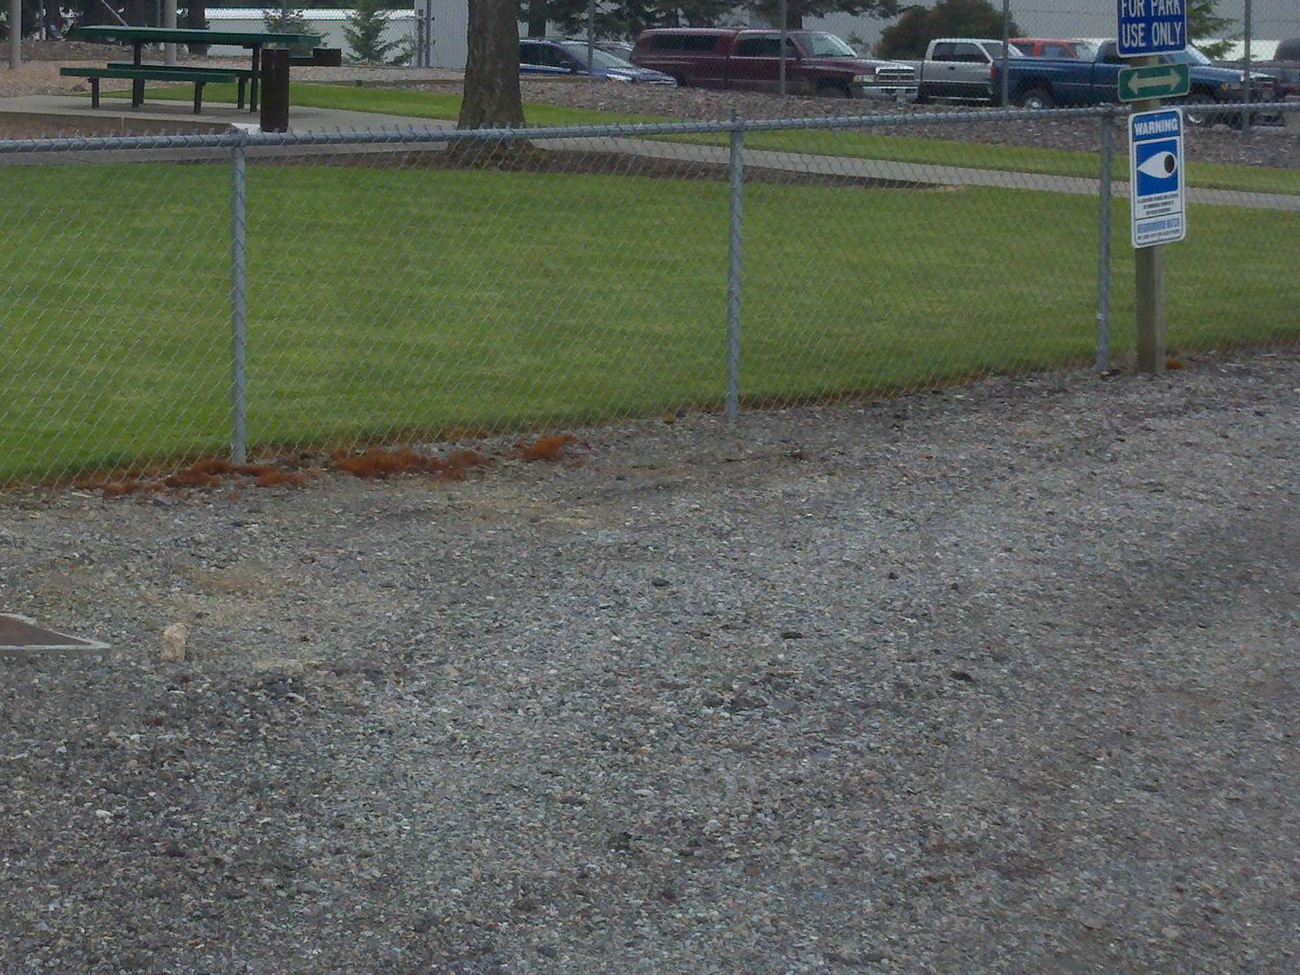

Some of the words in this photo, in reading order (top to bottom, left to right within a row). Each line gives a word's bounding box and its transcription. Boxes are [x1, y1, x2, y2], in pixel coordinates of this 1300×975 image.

[1122, 23, 1146, 48] USE
[1151, 22, 1182, 46] ONLY
[1134, 119, 1178, 135] WARNING
